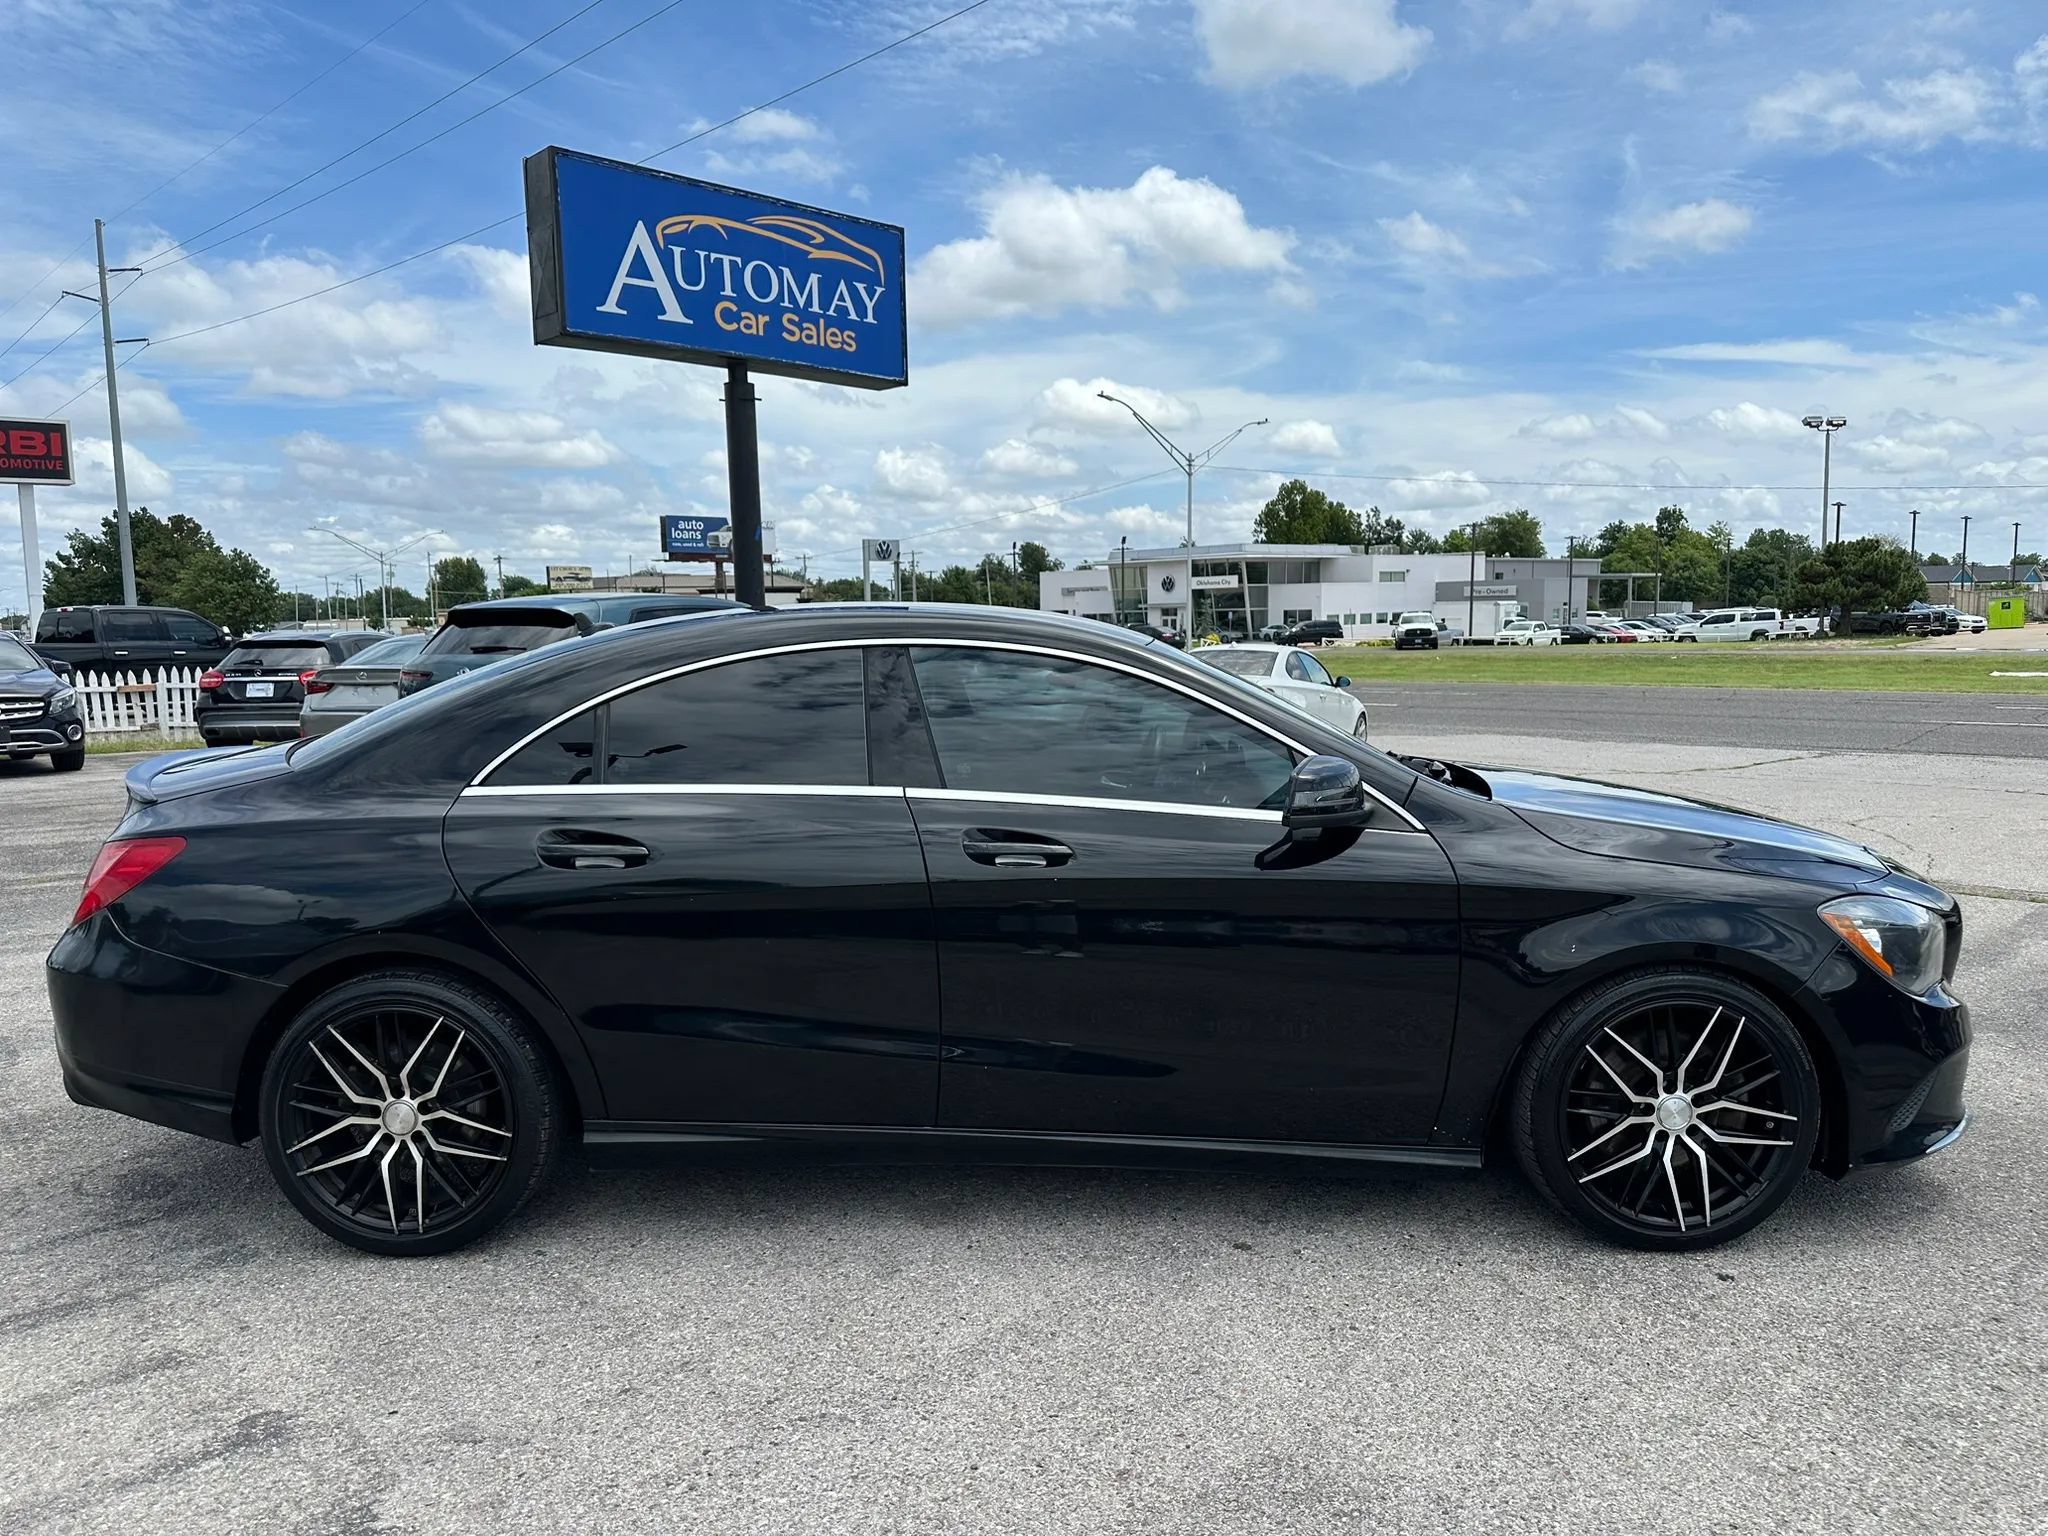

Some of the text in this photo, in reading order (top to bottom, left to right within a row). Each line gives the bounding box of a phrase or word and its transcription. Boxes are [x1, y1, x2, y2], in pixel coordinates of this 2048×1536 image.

[596, 220, 886, 325] AUTOMAY
[714, 301, 857, 353] Car Sales
[0, 430, 63, 457] BI
[671, 527, 702, 540] loans
[678, 520, 704, 530] auto
